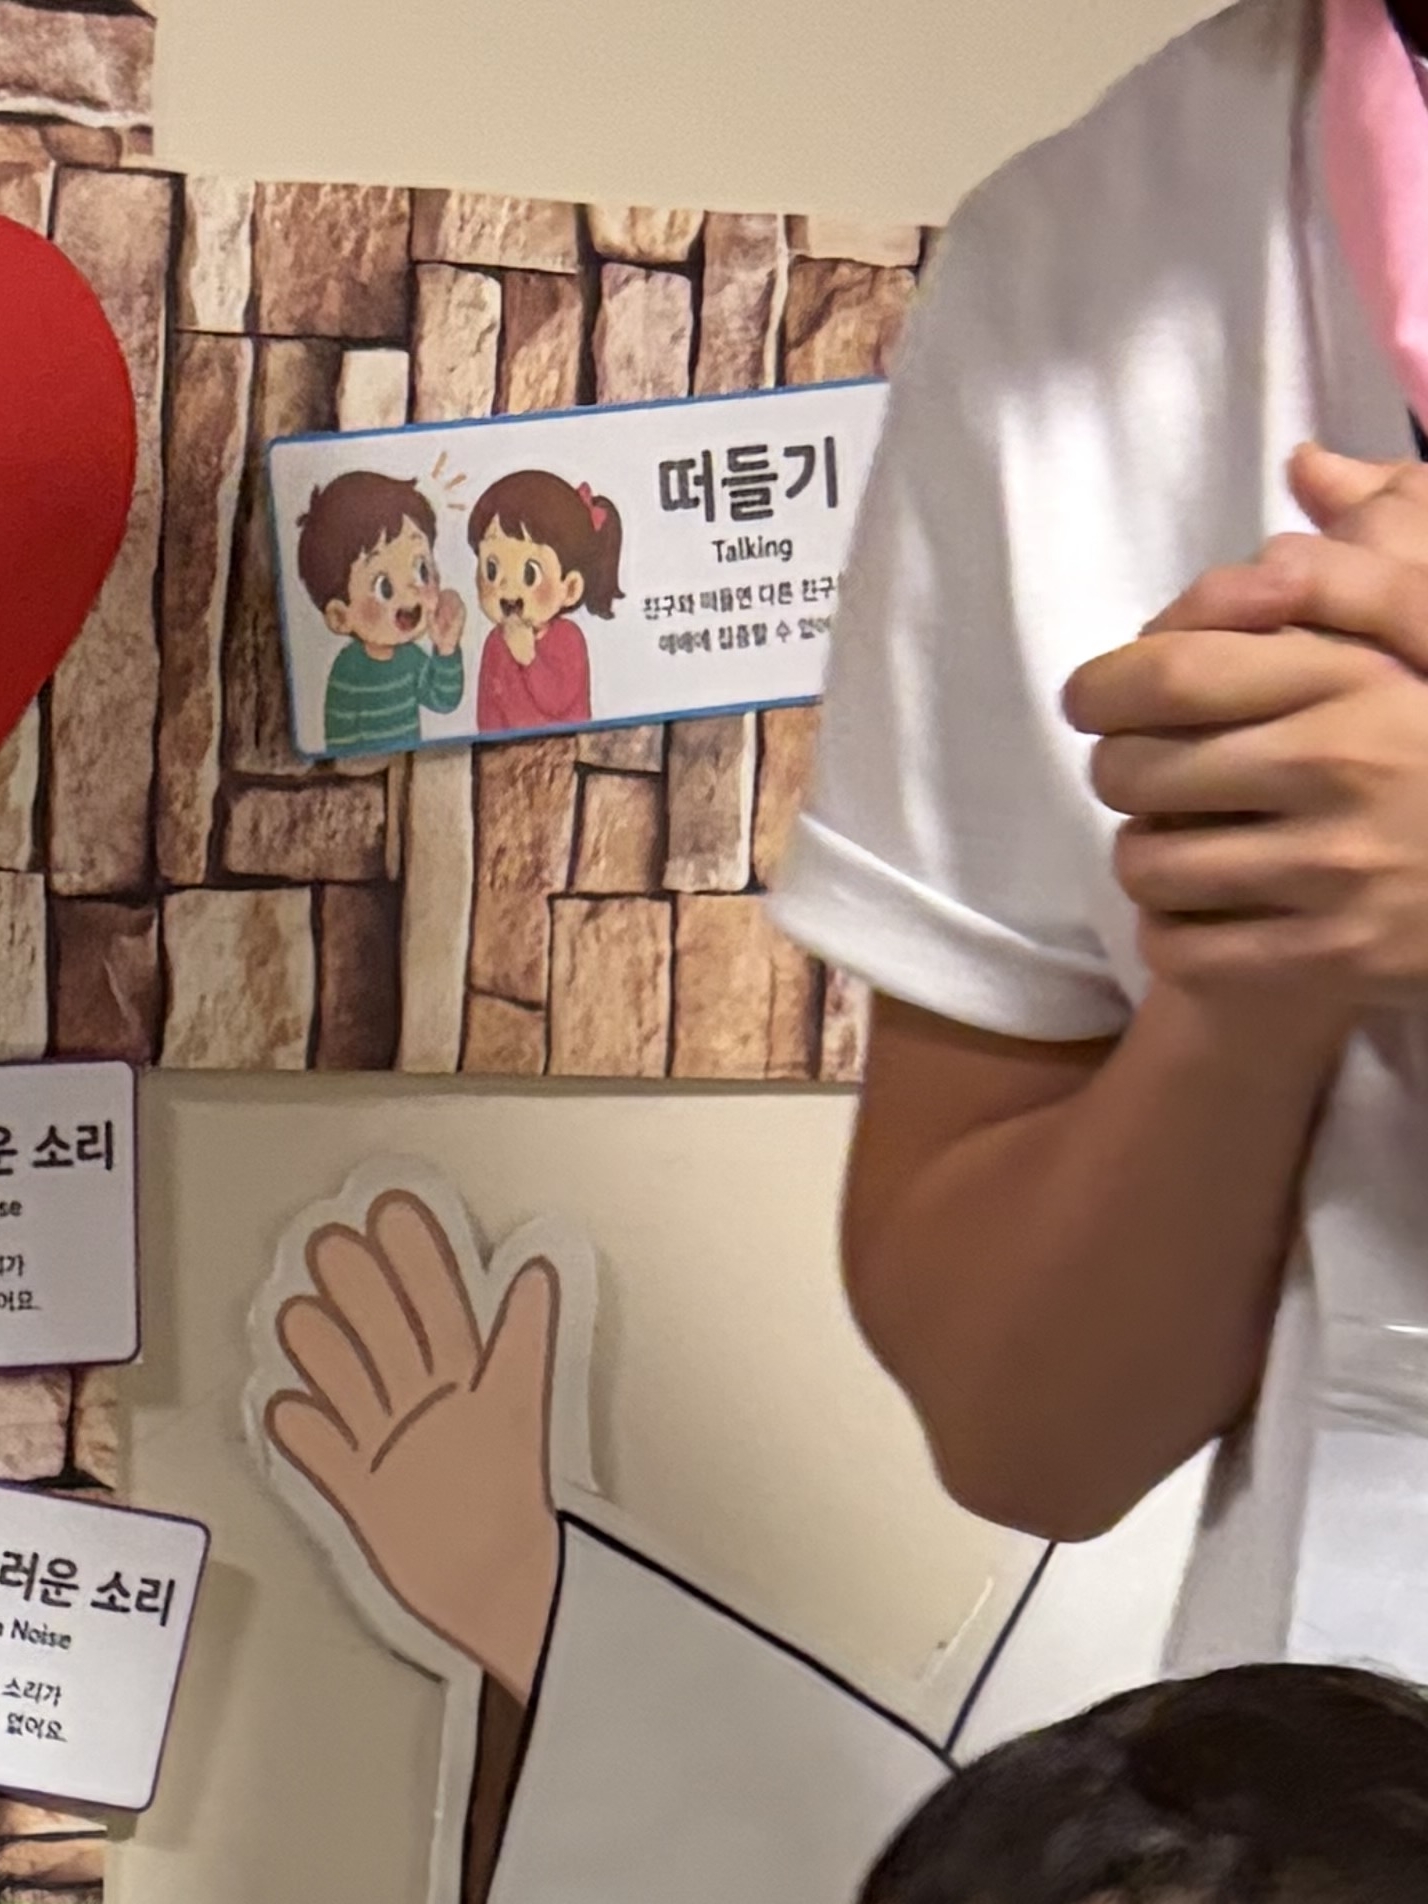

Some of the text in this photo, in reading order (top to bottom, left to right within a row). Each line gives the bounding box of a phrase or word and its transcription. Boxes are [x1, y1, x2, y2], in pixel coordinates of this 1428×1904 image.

[659, 436, 837, 522] 떠들기
[711, 536, 793, 562] Talking
[802, 576, 835, 601] 친구
[777, 620, 792, 643] 수
[32, 1120, 114, 1171] 소리
[91, 1572, 175, 1627] 소리
[11, 1618, 72, 1650] Noise
[1, 1679, 61, 1707] 소리가
